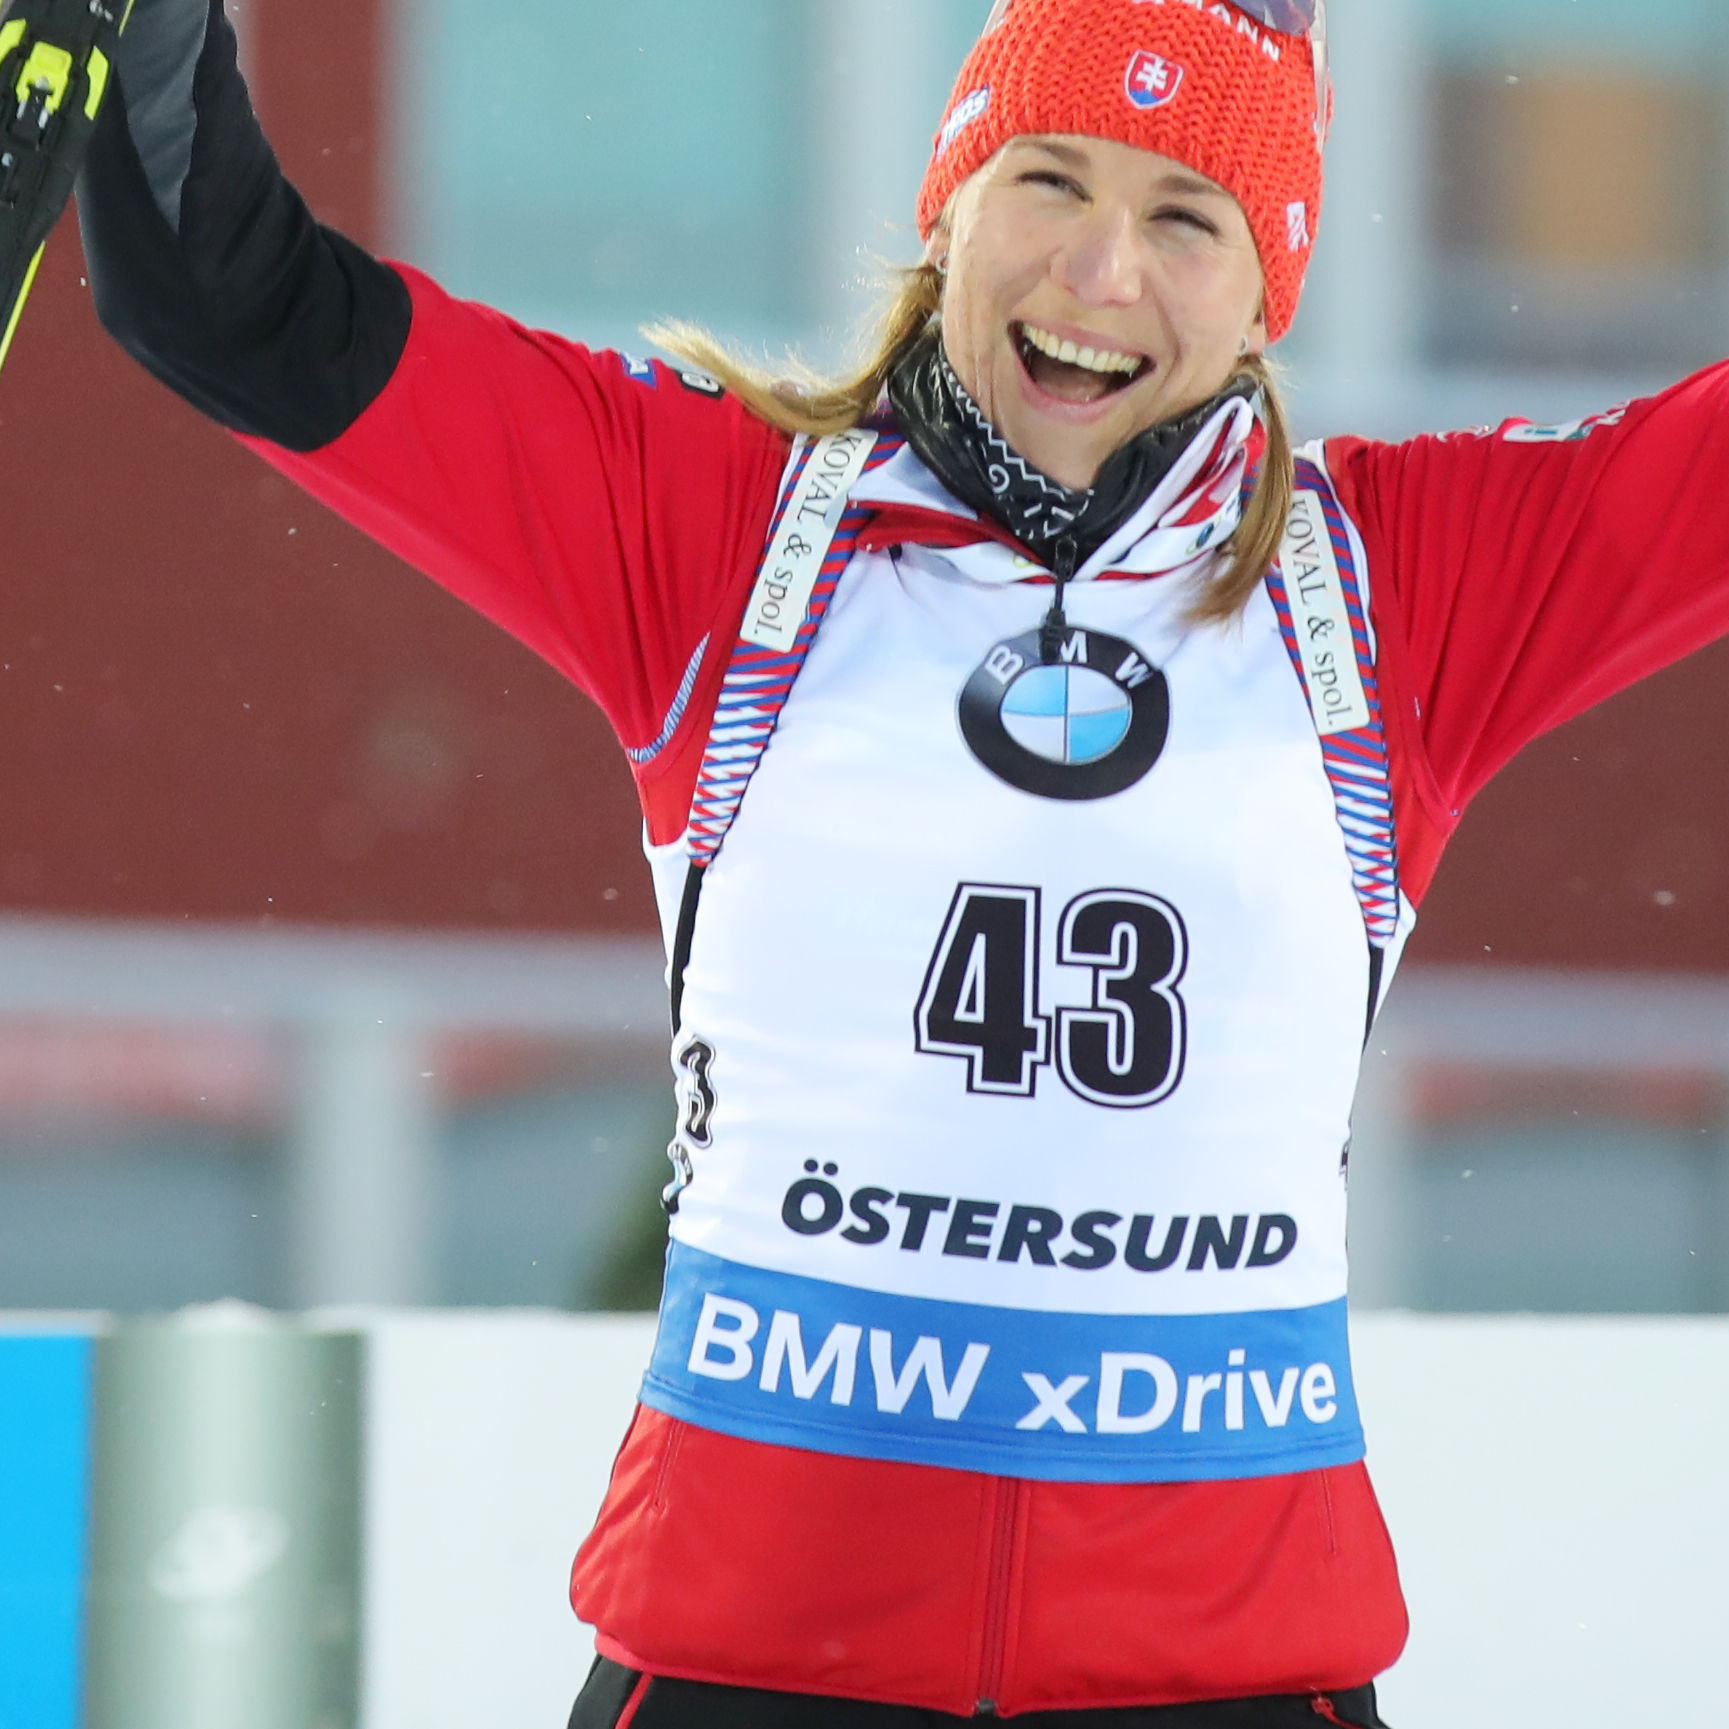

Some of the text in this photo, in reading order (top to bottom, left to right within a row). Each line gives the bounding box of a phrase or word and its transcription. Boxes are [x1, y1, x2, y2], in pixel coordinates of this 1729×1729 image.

[753, 429, 864, 635] KOVAL & spol.
[1285, 497, 1353, 726] KOVAL & spol.
[984, 629, 1154, 689] BMW
[913, 880, 1190, 1109] 43
[780, 1158, 1298, 1273] ÖSTERSUND
[686, 1291, 1338, 1435] BMW xDrive
